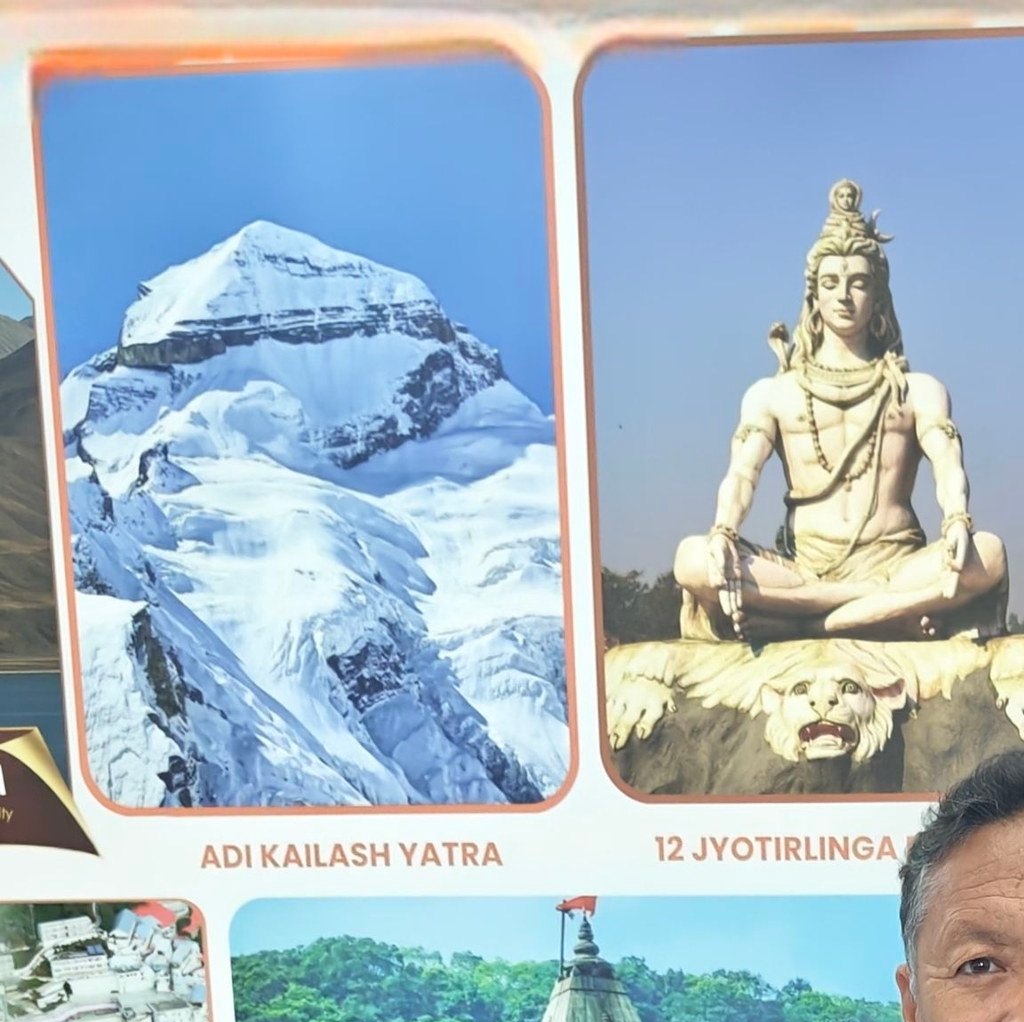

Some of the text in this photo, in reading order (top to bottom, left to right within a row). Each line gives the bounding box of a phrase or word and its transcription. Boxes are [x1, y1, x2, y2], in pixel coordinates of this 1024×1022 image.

[202, 842, 502, 868] ADI KAILASH YATRA
[655, 836, 684, 862] 12
[692, 835, 897, 862] JYOTIRLINGA
